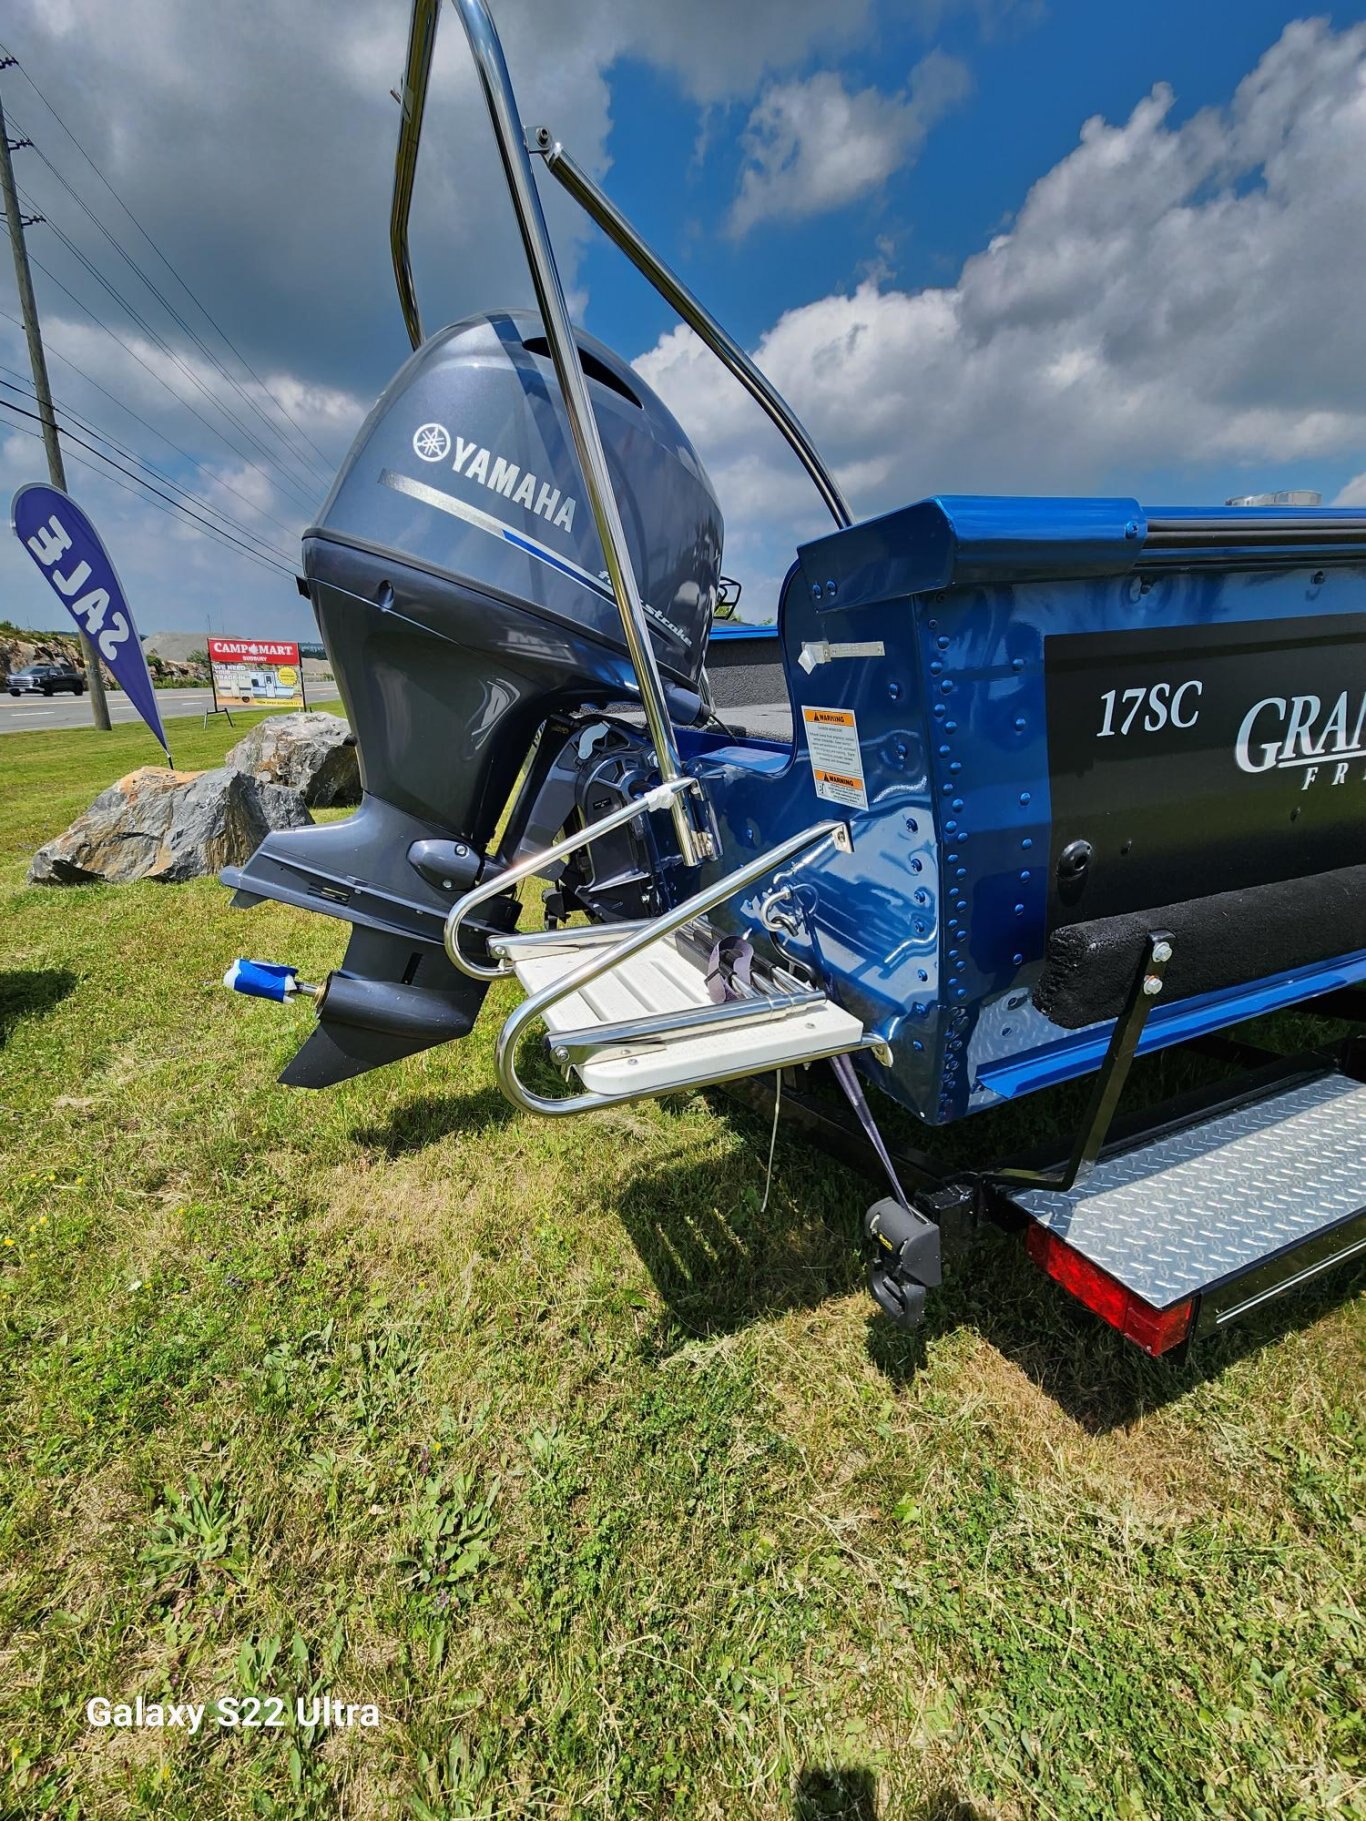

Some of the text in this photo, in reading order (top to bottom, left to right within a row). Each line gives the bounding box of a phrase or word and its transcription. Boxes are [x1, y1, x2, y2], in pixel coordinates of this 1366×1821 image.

[452, 437, 576, 533] YAMAHA
[213, 643, 293, 656] CAMP MART
[819, 714, 845, 723] WARNING
[1096, 680, 1203, 737] 17SC
[829, 774, 854, 787] WARNING
[1301, 762, 1366, 791] FR
